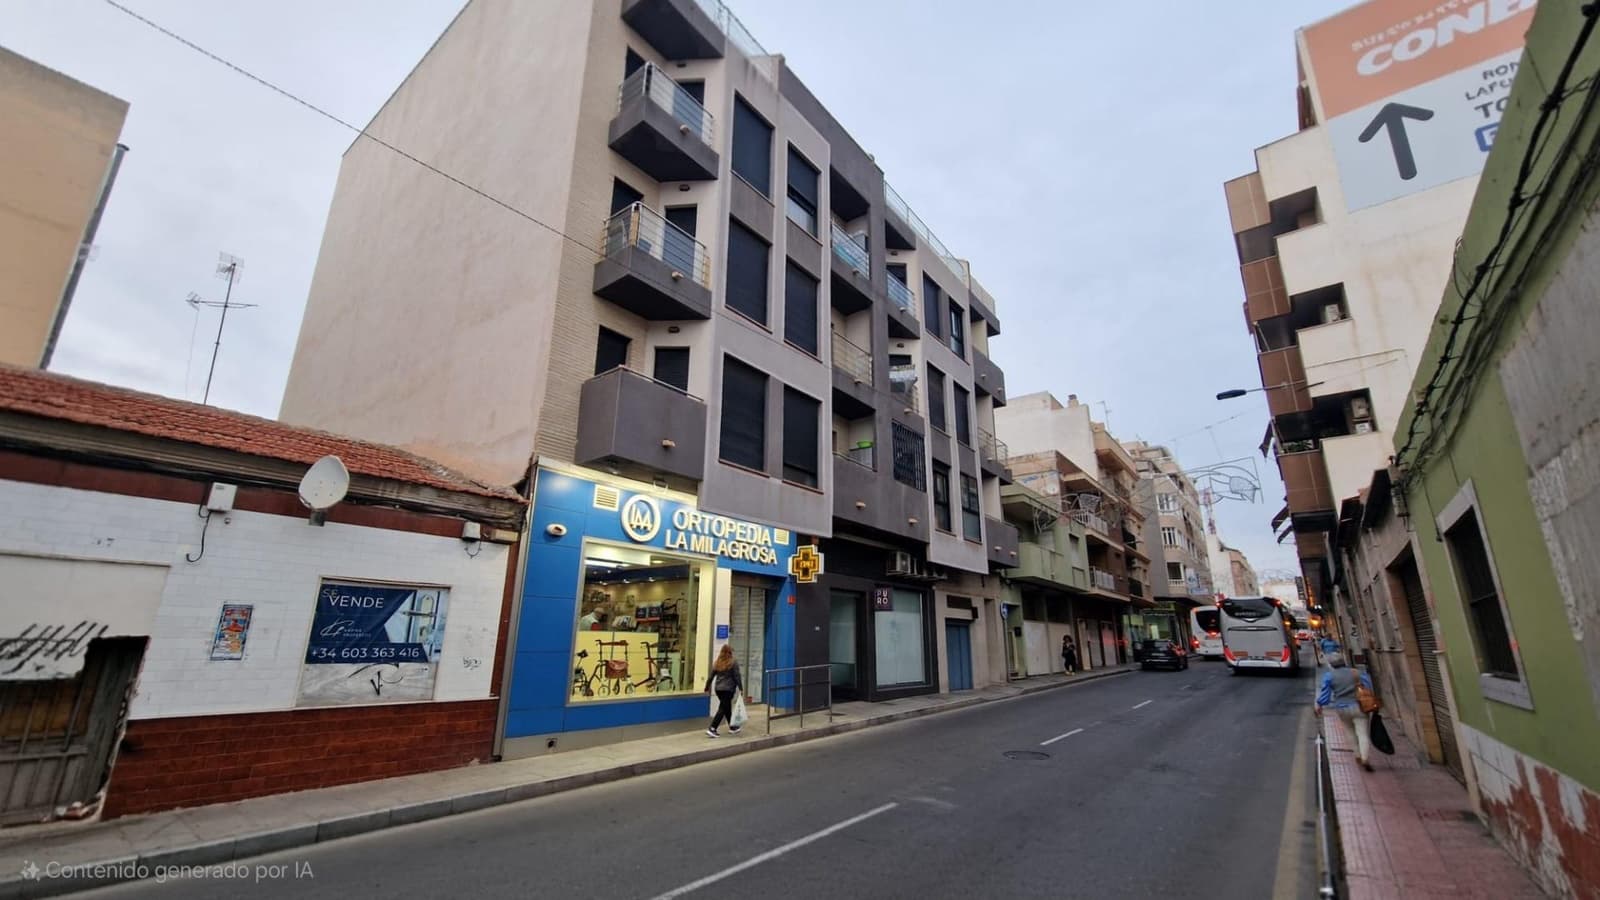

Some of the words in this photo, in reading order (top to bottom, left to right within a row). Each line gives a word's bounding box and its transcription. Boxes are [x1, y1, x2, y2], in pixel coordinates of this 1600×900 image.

[672, 508, 772, 547] ORTOPEDIA
[666, 529, 687, 550] LA
[690, 536, 778, 565] MILAGROSA
[328, 595, 385, 609] VENDE
[312, 647, 336, 659] +34
[341, 647, 367, 658] 603
[371, 647, 395, 658] 363
[399, 647, 420, 658] 416
